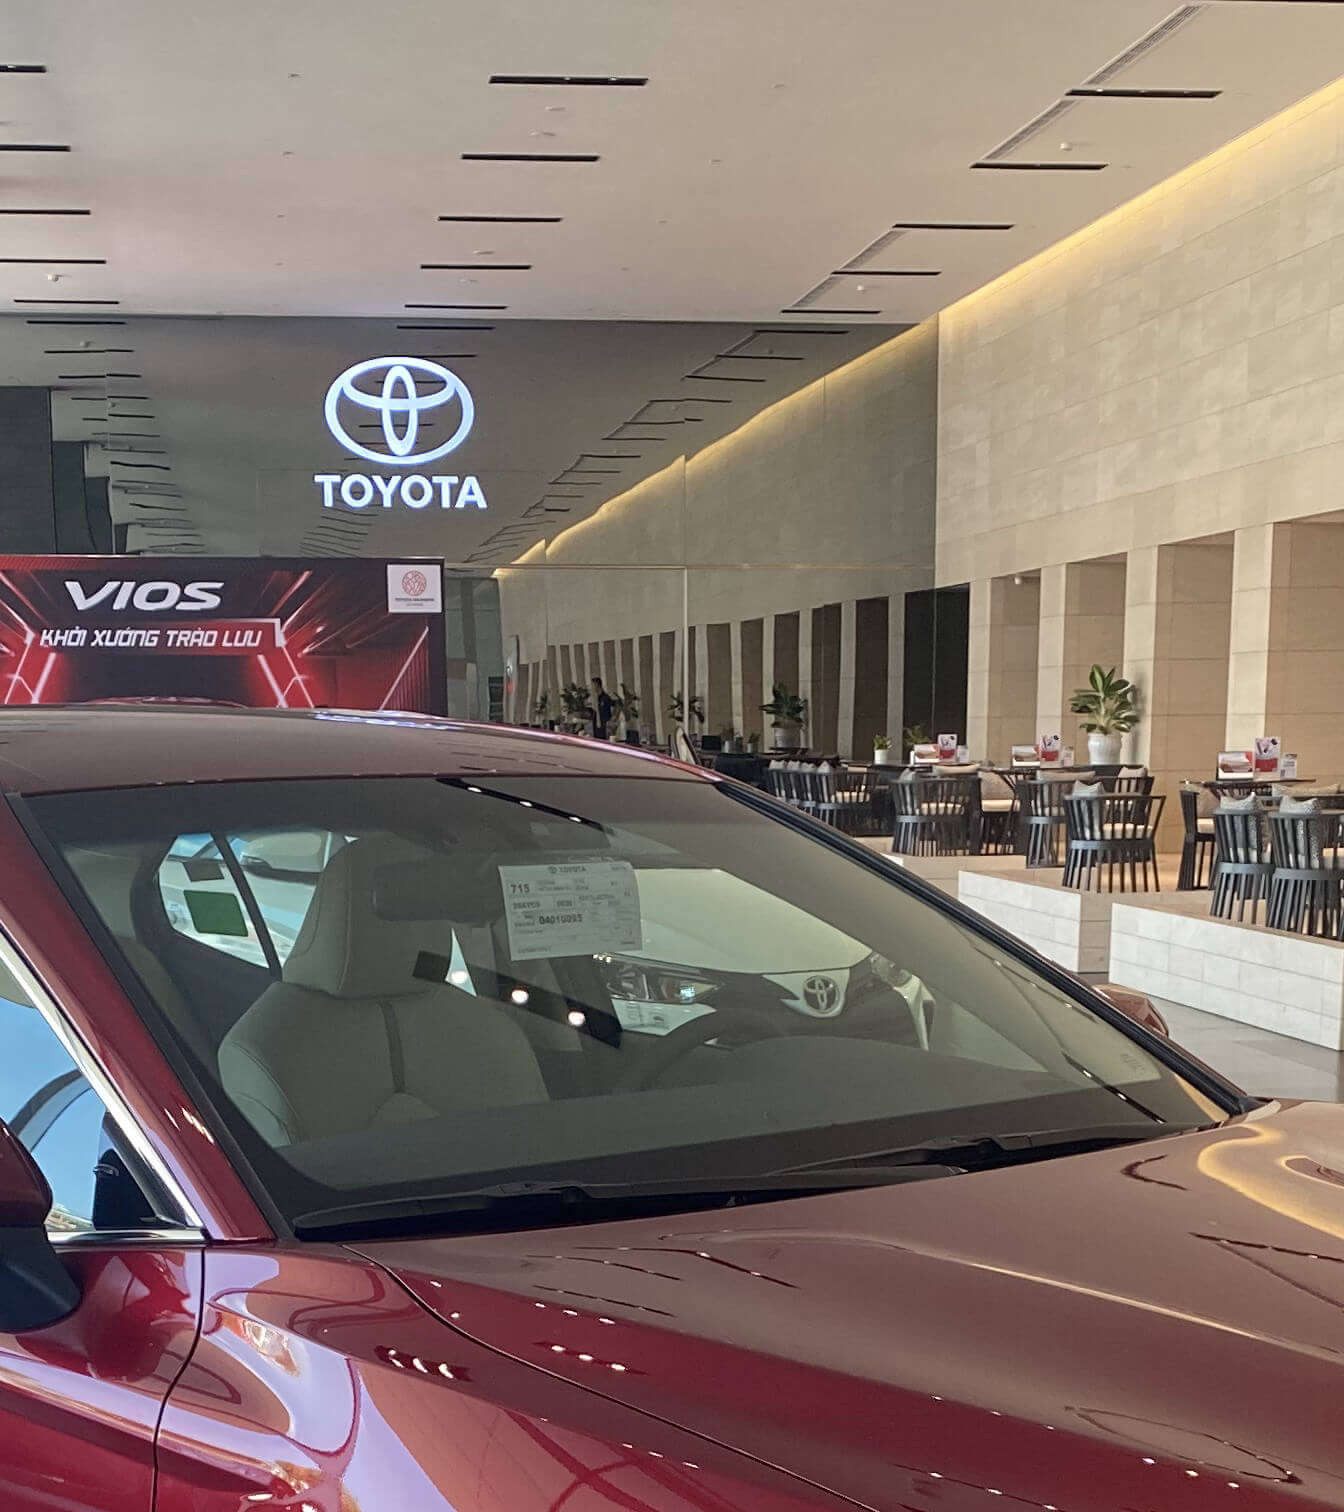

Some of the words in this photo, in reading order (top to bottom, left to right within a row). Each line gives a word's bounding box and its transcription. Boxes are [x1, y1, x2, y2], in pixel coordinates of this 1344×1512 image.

[314, 474, 488, 508] TOYOTA
[64, 581, 224, 610] VIOS
[510, 884, 530, 894] 715
